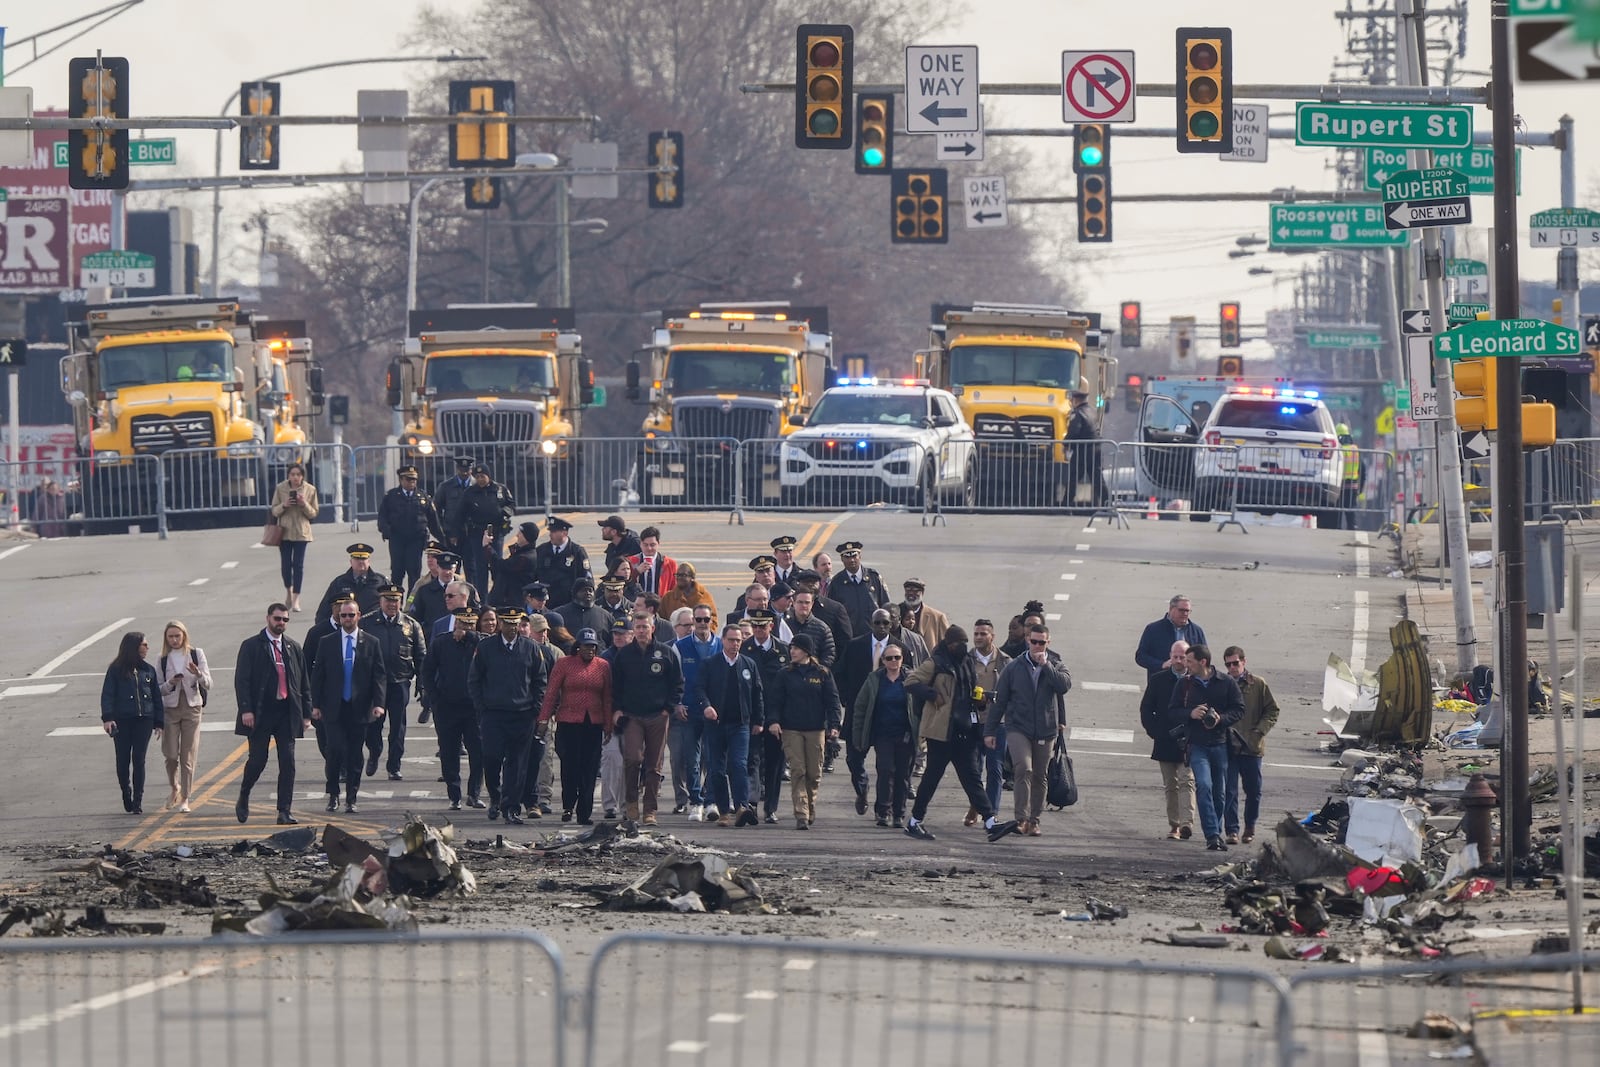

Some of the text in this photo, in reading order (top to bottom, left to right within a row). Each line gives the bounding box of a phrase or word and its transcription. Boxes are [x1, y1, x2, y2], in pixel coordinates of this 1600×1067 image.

[920, 54, 964, 72] ONE
[919, 78, 964, 96] WAY
[1233, 109, 1256, 122] NO
[1235, 124, 1260, 134] URN
[1311, 112, 1457, 139] Rupert St
[1236, 136, 1252, 145] ON
[138, 144, 171, 160] Blvd
[1373, 150, 1463, 167] Roovelt
[1427, 170, 1446, 178] 7200
[969, 181, 999, 193] ONE
[1386, 179, 1467, 200] RUPERT ST
[24, 200, 62, 213] 24HRS
[969, 195, 1001, 207] WAY
[1276, 208, 1358, 222] Roosevelt
[1411, 206, 1461, 219] ONE WAY
[1531, 215, 1588, 226] ROOSEVELT
[1538, 231, 1547, 243] N
[1592, 231, 1600, 242] S
[89, 272, 98, 283] N
[138, 272, 146, 283] S
[1501, 321, 1535, 331] N 7200
[1459, 331, 1576, 353] Leonard St
[138, 422, 205, 434] MACK
